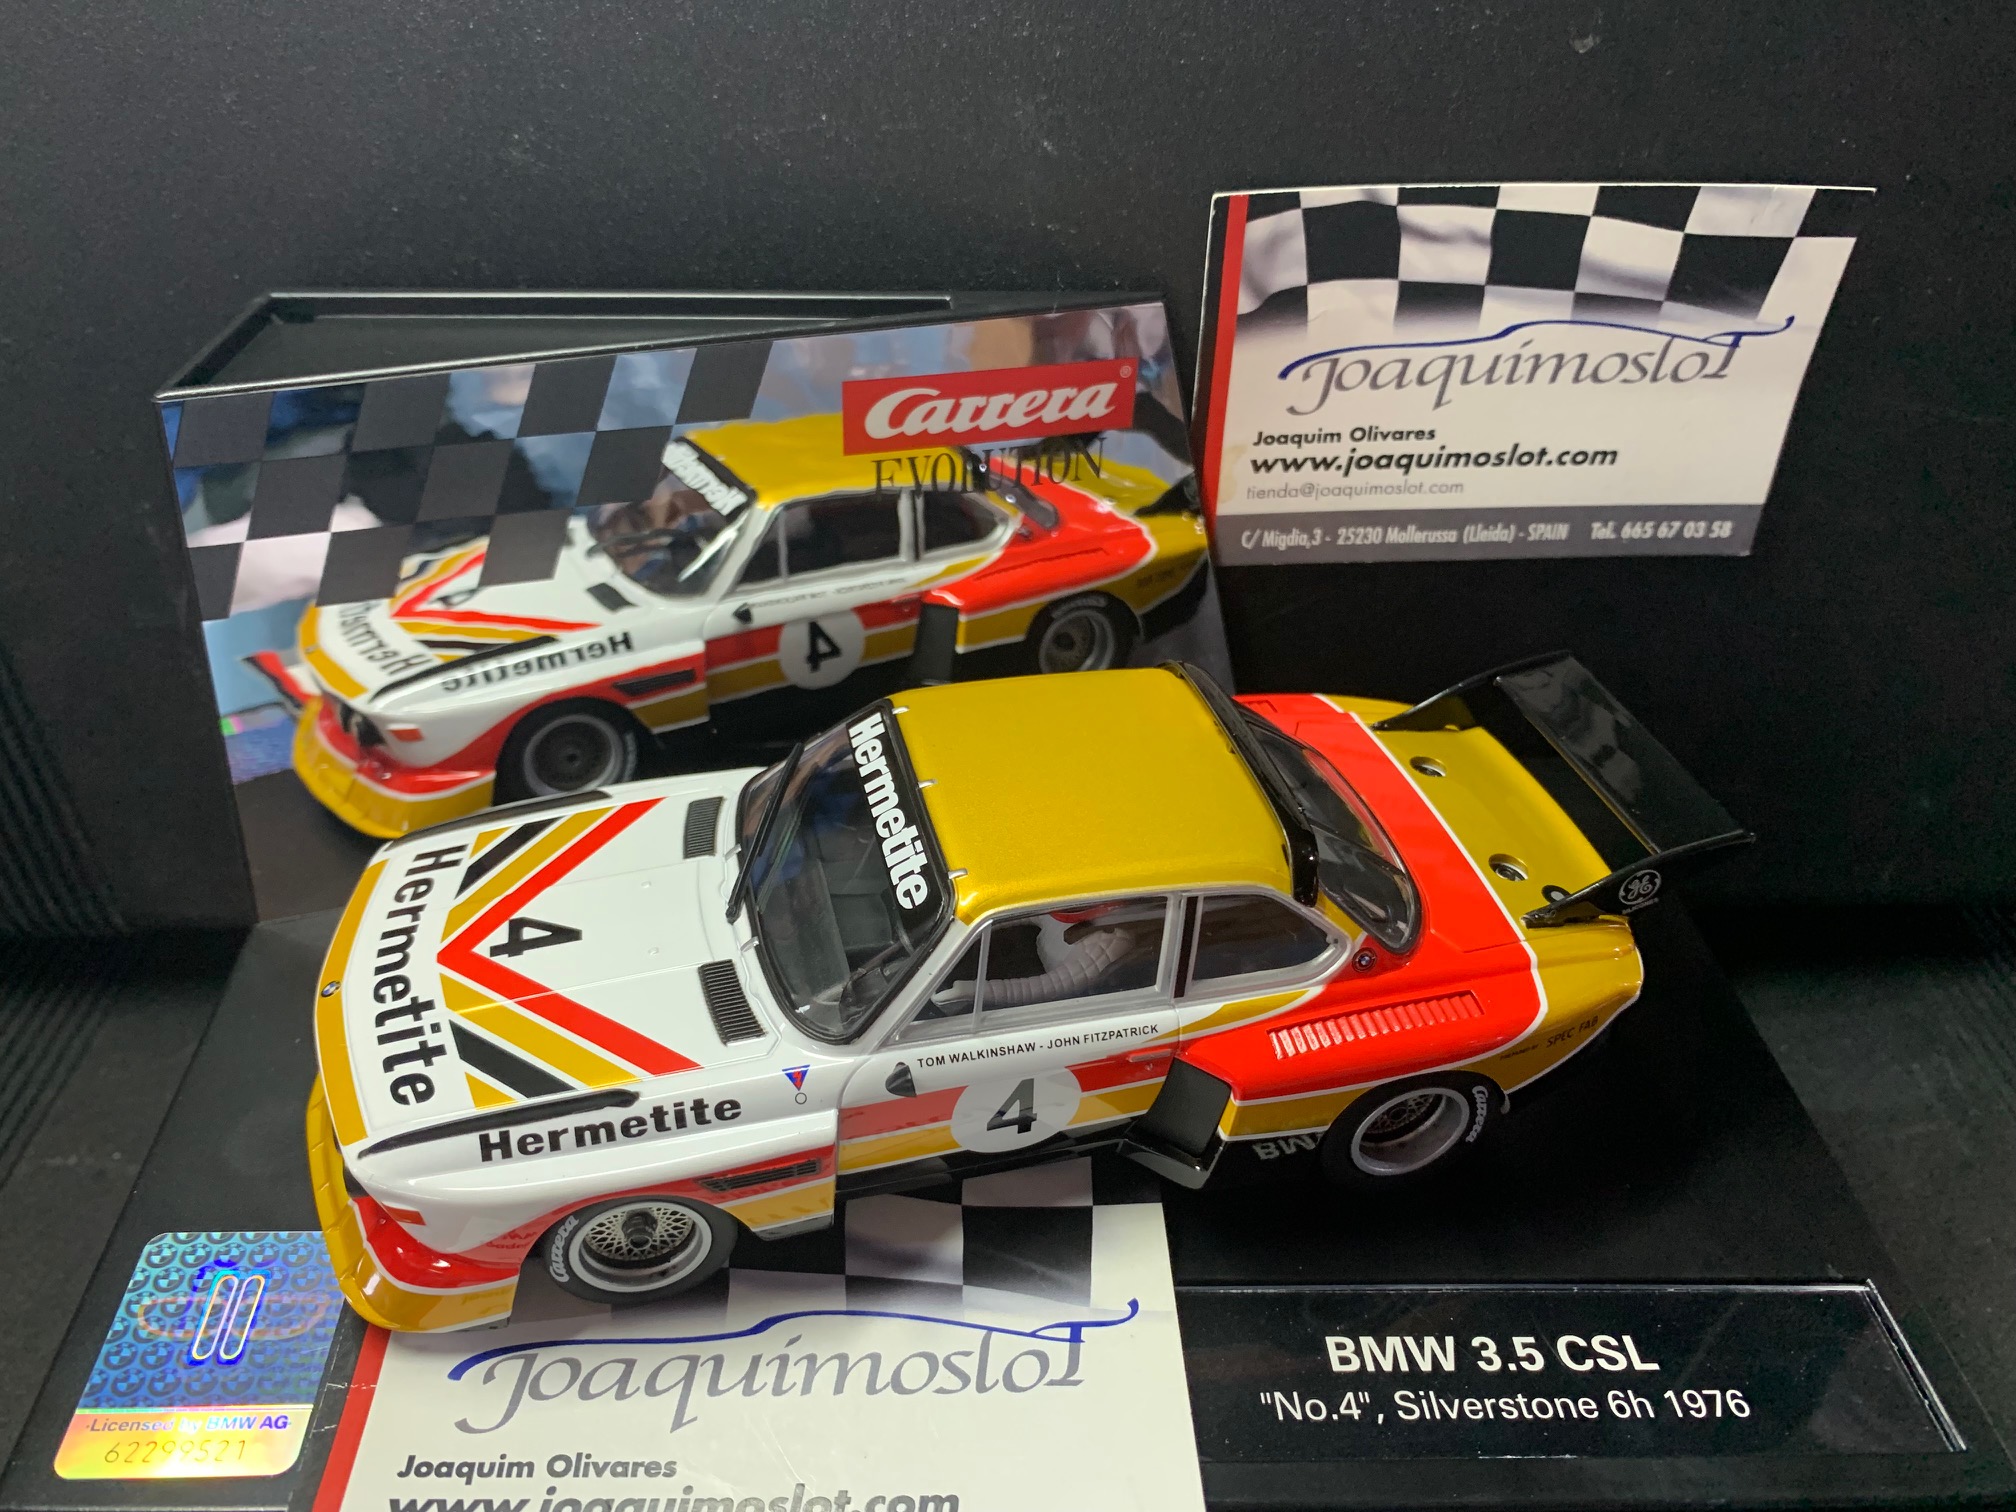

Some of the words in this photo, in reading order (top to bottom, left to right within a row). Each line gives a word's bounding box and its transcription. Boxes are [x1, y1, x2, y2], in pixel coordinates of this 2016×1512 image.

[864, 382, 1118, 439] Carrera
[1252, 428, 1342, 449] Joaquim
[1349, 426, 1436, 443] Olivares
[872, 437, 1108, 500] EVOLUTION
[1250, 443, 1618, 477] www.joaquimoslot.com
[1246, 479, 1464, 500] tienda@joaquimoslot.com
[1336, 526, 1383, 546] 25230
[1527, 522, 1571, 542] SPAIN
[1620, 520, 1656, 540] 665
[1657, 520, 1680, 540] 67
[1683, 519, 1708, 539] 03
[1709, 519, 1734, 539] 58
[847, 711, 928, 910] Hermetite
[489, 916, 583, 958] 4
[373, 843, 469, 1107] Hermetite
[917, 1055, 946, 1068] TOM
[948, 1042, 1036, 1063] WALKINSHAW
[1047, 1035, 1080, 1050] JOHN
[1083, 1024, 1159, 1044] FITZPATRICK
[1546, 1027, 1575, 1048] SPEC
[986, 1078, 1037, 1134] 4
[479, 1097, 742, 1163] Hermetite
[550, 1215, 579, 1283] Carrera
[1326, 1335, 1456, 1372] BMW
[1472, 1336, 1545, 1372] 3.5
[1556, 1335, 1660, 1372] CSL
[89, 1418, 173, 1432] Licensed
[206, 1416, 257, 1430] BMW
[259, 1415, 288, 1430] AG
[1260, 1390, 1384, 1425] "No.4",
[1394, 1389, 1599, 1420] Silverstone
[1607, 1389, 1655, 1419] 6h
[1664, 1389, 1750, 1418] 1976
[396, 1453, 535, 1486] Joaquim
[546, 1452, 678, 1478] Olivares
